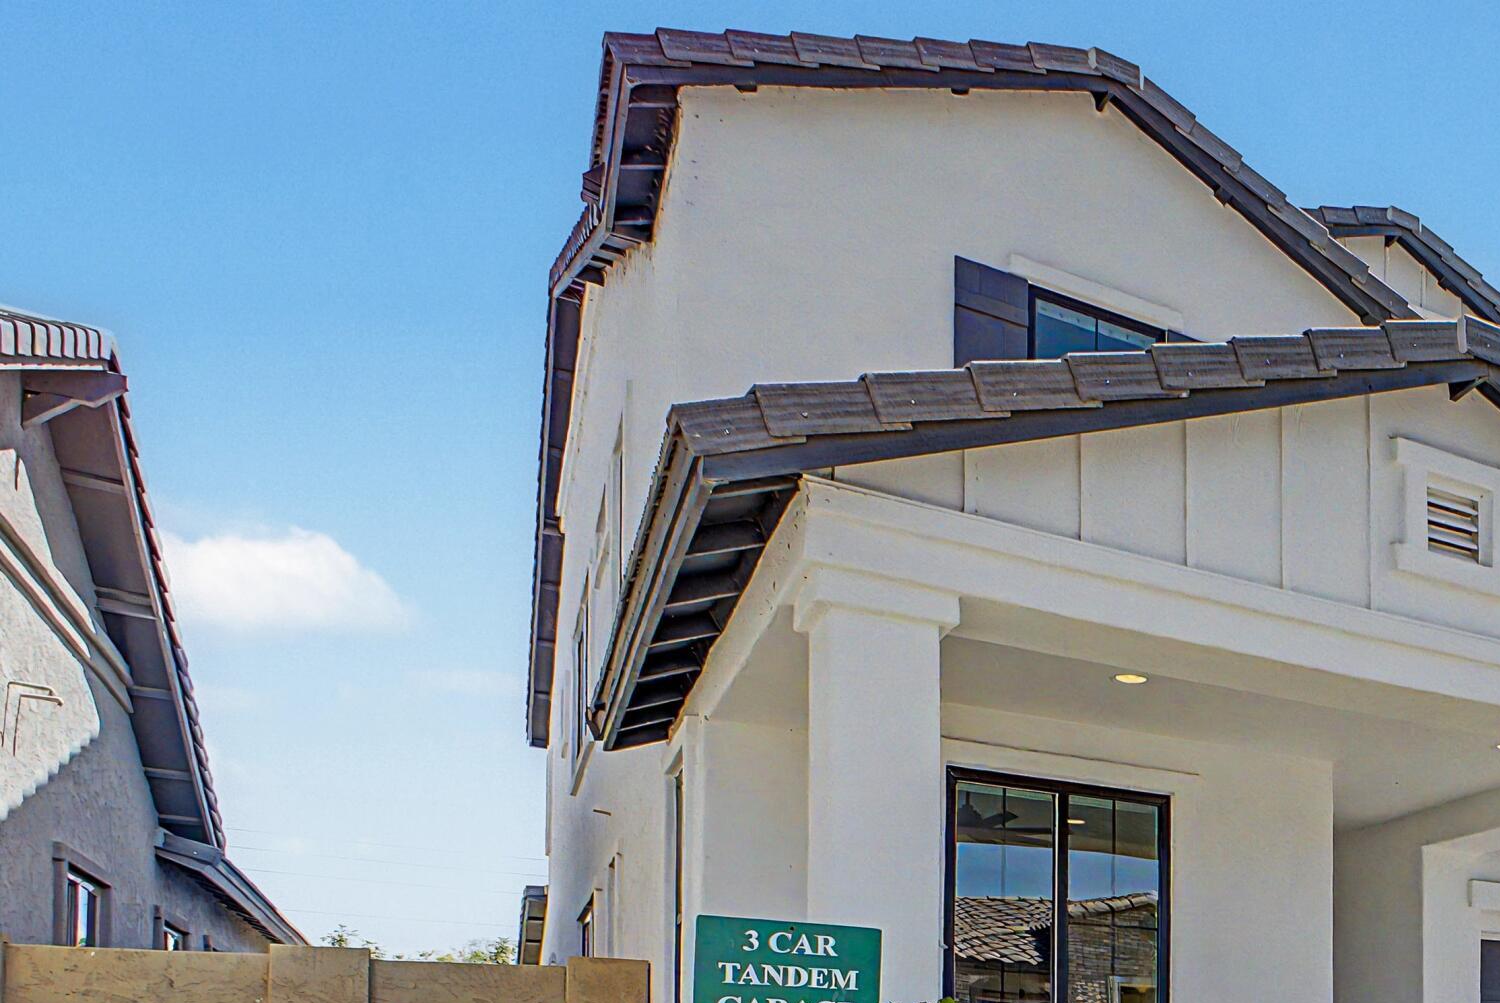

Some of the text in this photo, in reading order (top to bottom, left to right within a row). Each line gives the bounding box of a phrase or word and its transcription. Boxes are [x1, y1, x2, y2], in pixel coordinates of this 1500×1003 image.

[742, 930, 838, 957] 3 CAR
[718, 961, 859, 991] TANDEM
